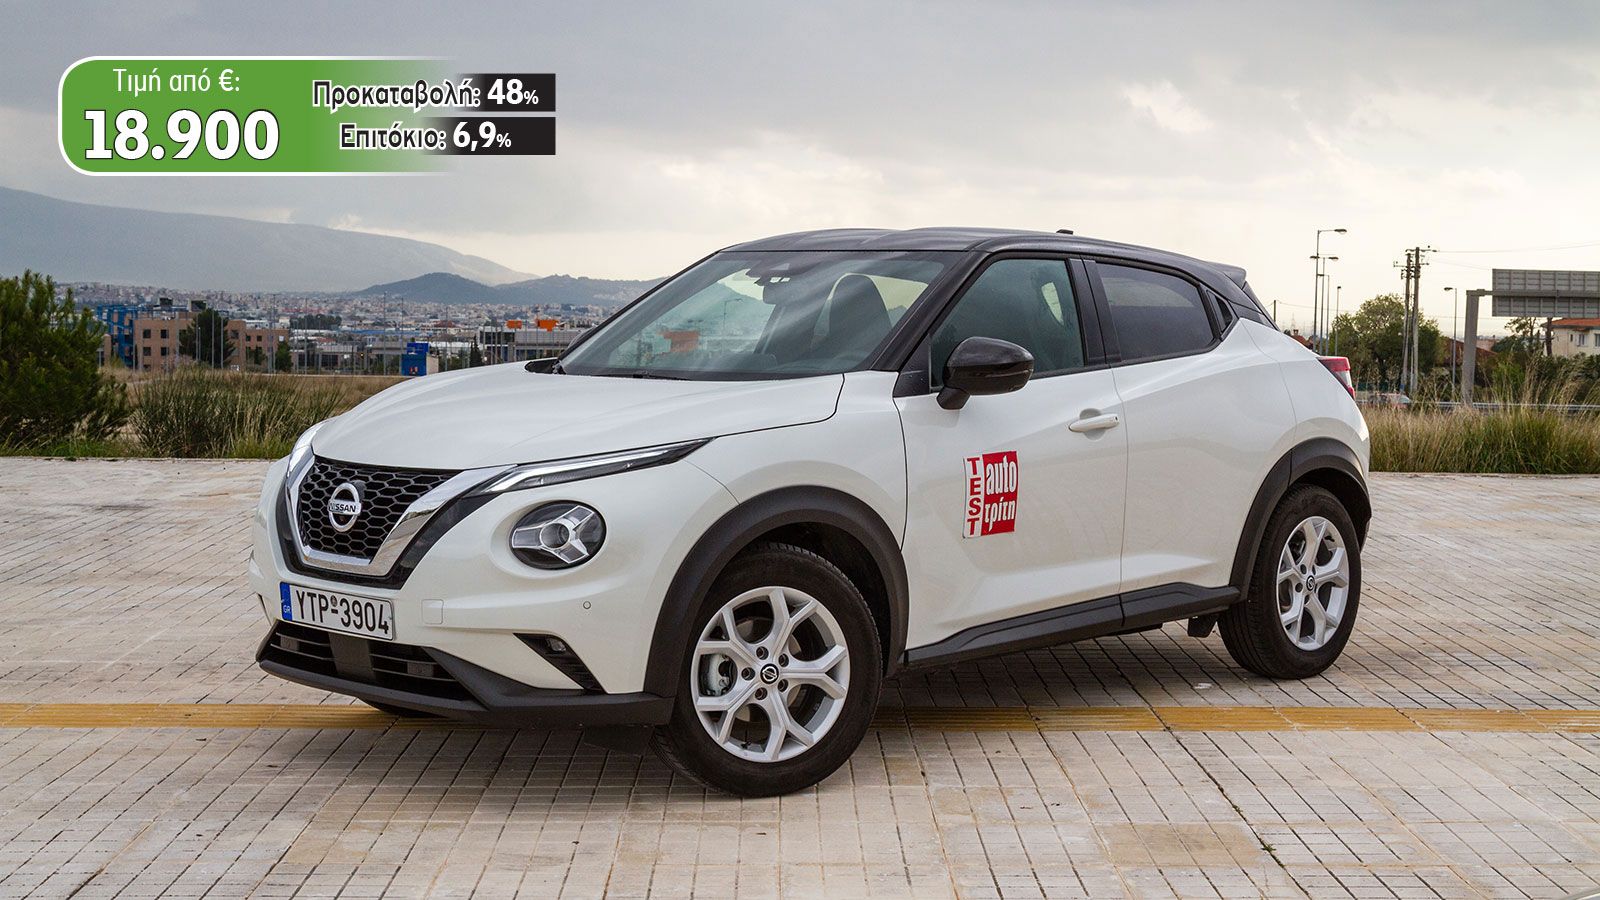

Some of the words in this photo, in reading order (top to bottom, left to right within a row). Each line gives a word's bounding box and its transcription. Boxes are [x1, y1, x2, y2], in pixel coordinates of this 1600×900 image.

[986, 455, 1017, 495] auto
[329, 502, 356, 513] NISSAN
[966, 457, 982, 536] TEST
